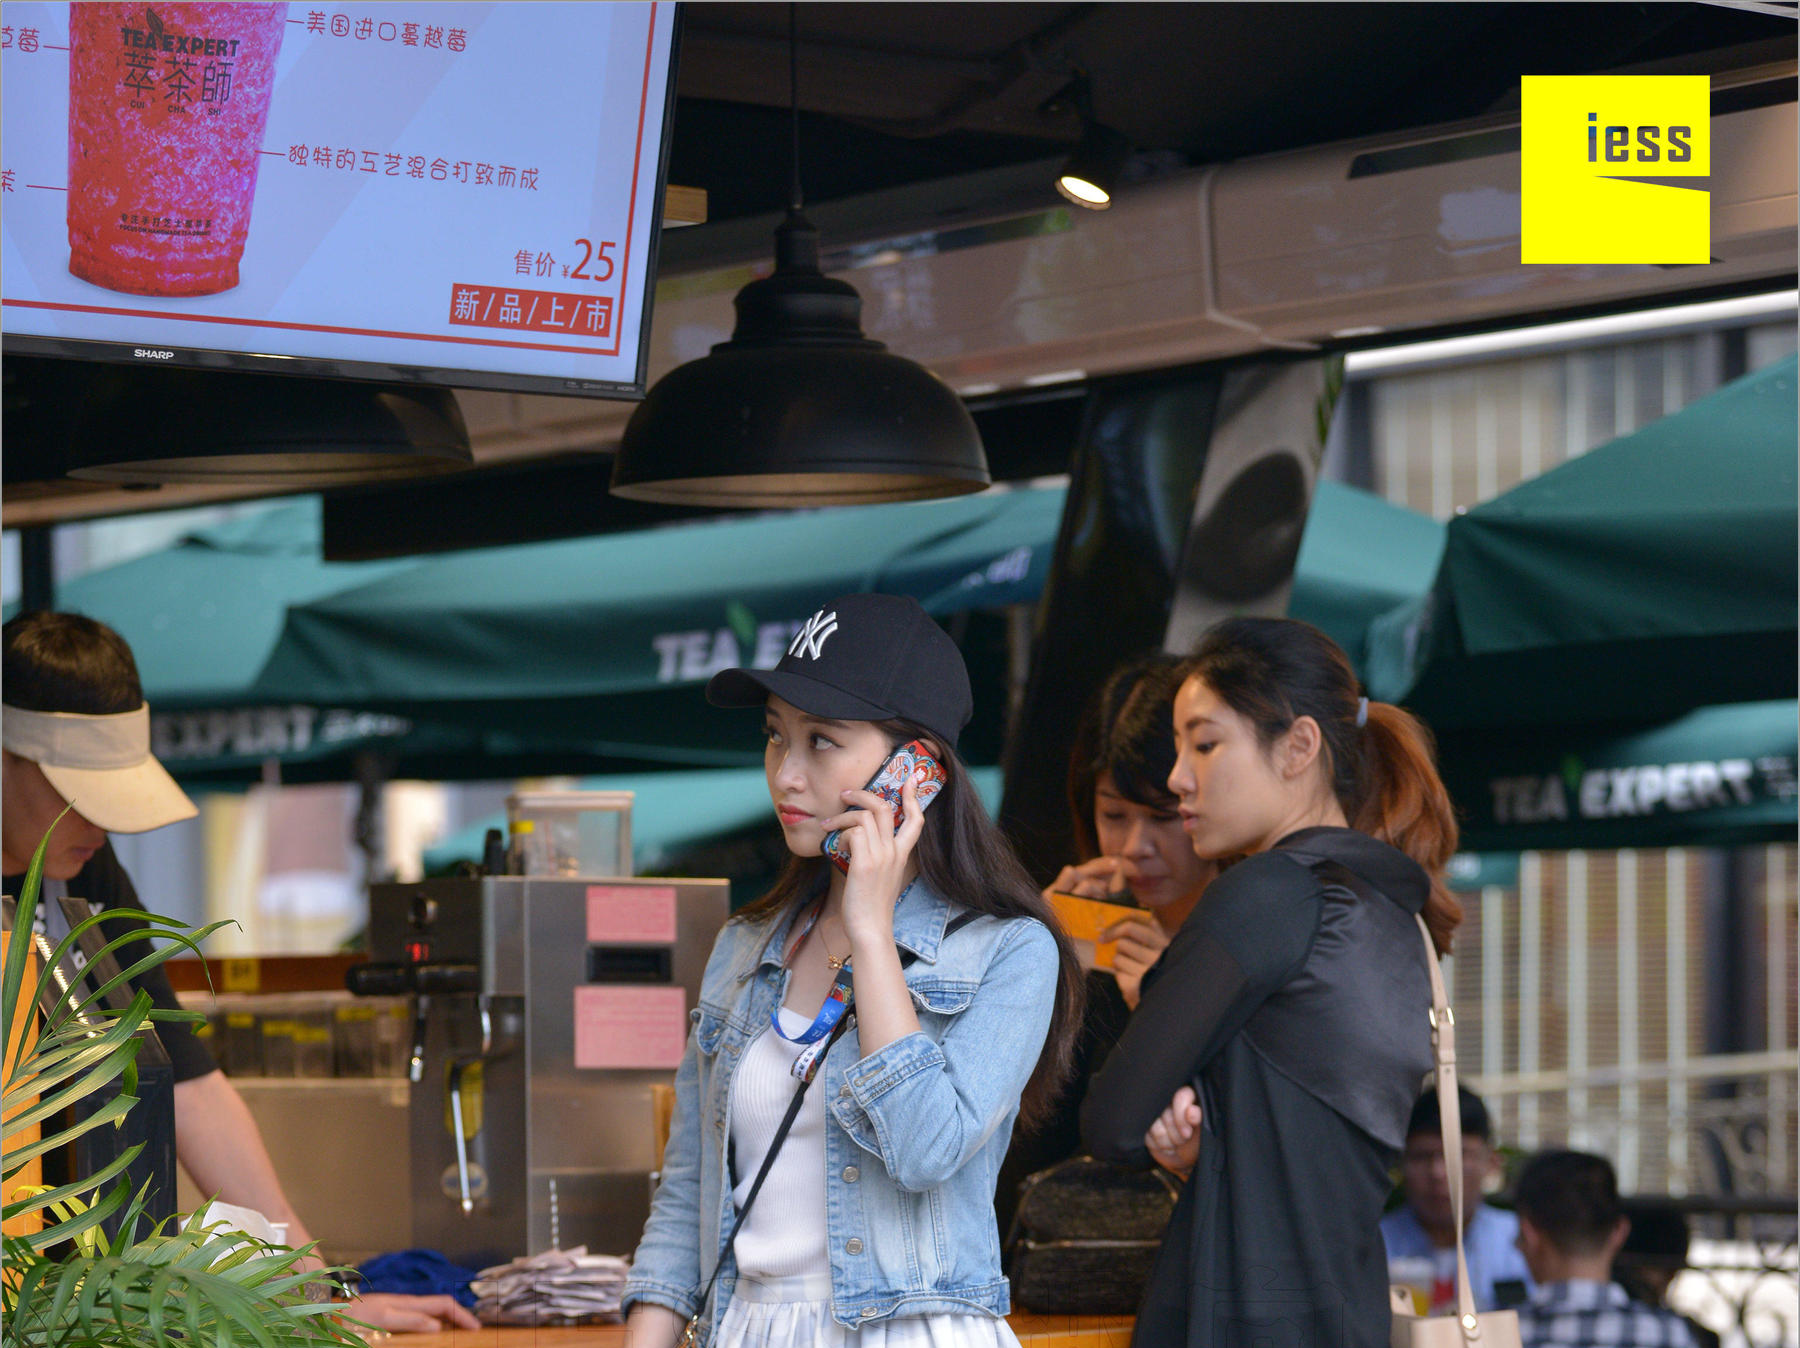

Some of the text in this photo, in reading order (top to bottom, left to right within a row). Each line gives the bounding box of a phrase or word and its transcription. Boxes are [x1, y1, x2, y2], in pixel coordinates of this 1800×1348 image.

[121, 28, 240, 57] TEA EXPERT
[307, 10, 468, 53] 美国进口蔓越莓
[130, 100, 221, 116] CUI CHA SHI
[514, 250, 556, 278] 售价
[134, 349, 174, 359] SHARP
[788, 609, 838, 661] NY
[653, 627, 740, 683] TEA
[1578, 757, 1753, 819] EXPERT
